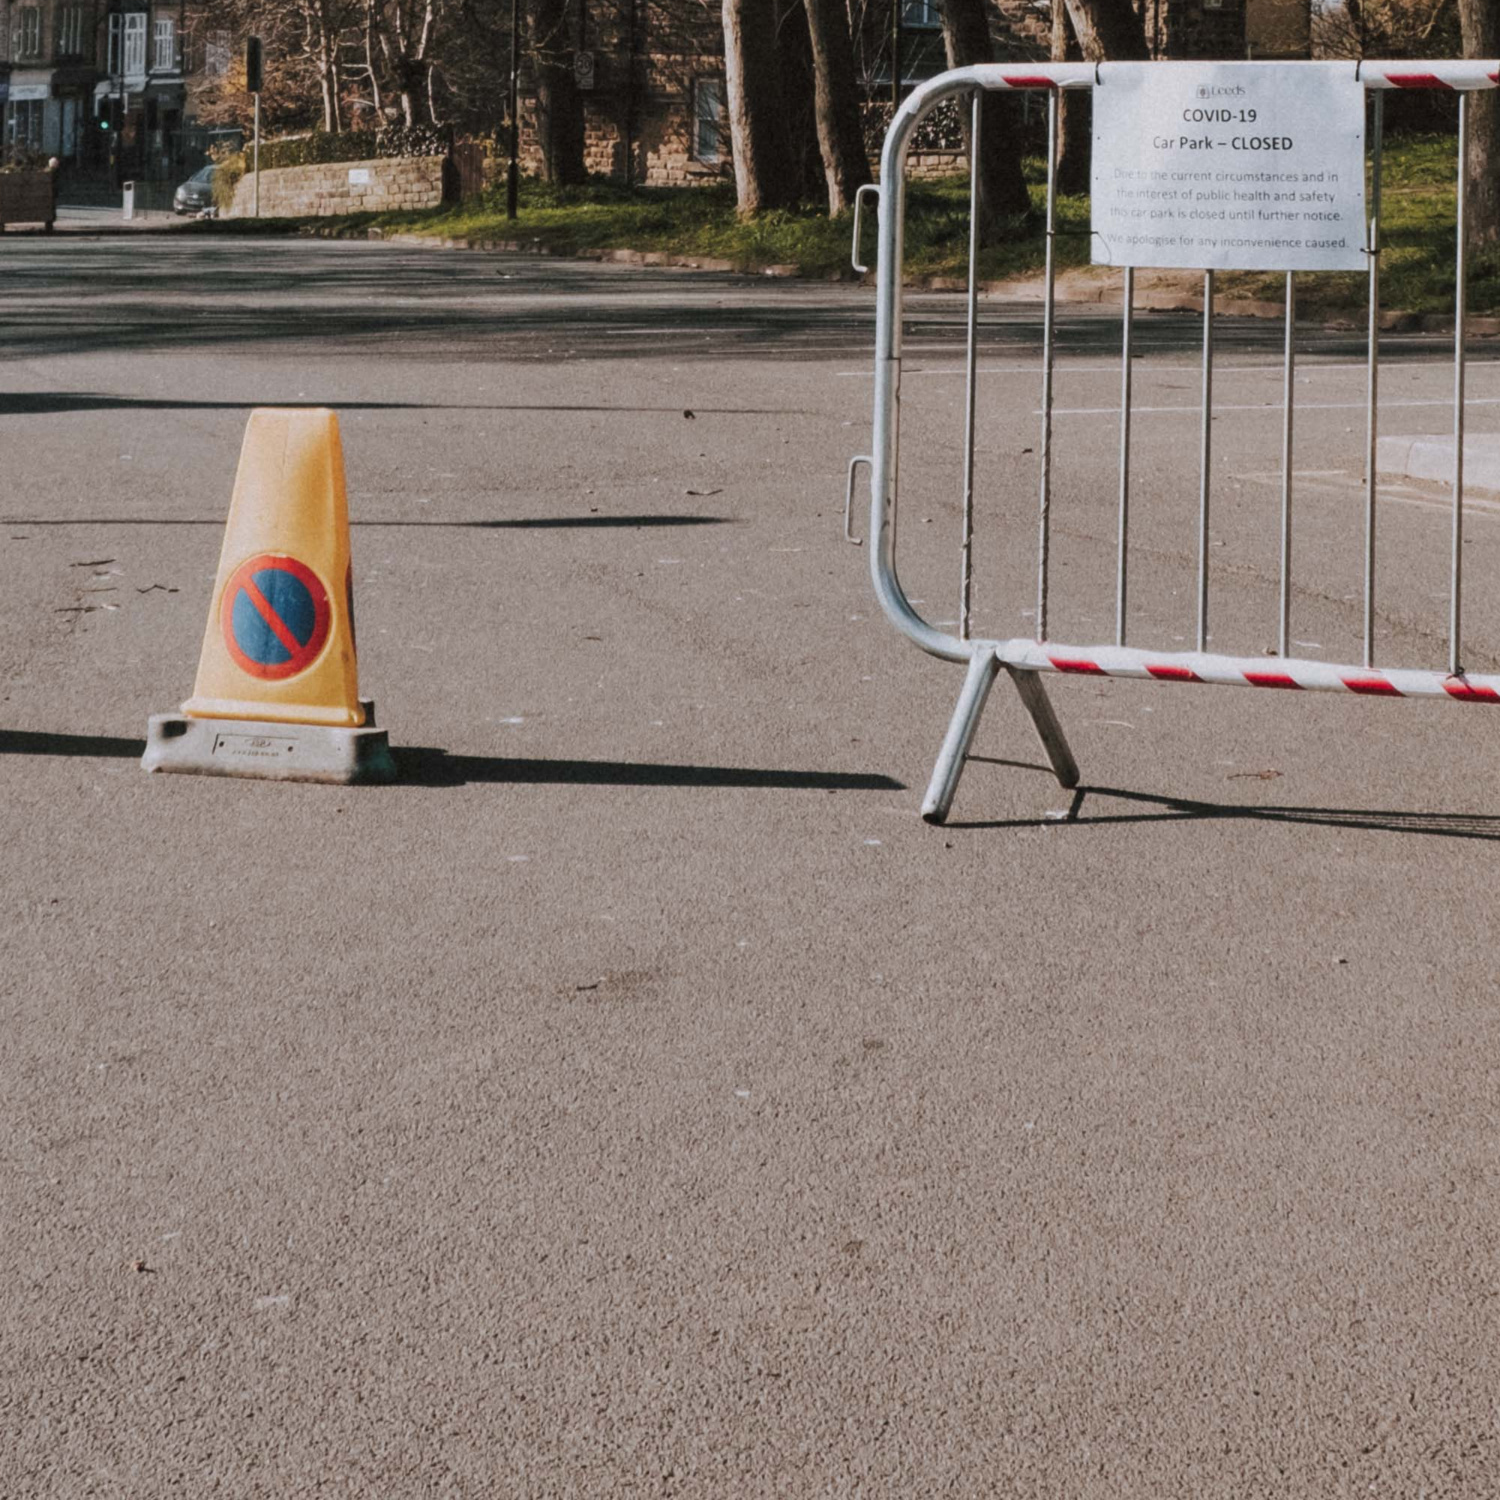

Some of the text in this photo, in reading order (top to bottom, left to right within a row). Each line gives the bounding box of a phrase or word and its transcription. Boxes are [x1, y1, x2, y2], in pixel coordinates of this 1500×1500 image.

[1183, 109, 1257, 123] COVID-19
[1153, 136, 1173, 149] Car
[1180, 137, 1213, 150] Park
[1231, 137, 1293, 150] CLOSED
[1114, 169, 1134, 179] Due
[1151, 171, 1168, 180] the
[1171, 172, 1211, 181] current
[1216, 172, 1298, 182] circumstances
[1302, 172, 1324, 182] and
[1328, 173, 1338, 182] in
[1117, 188, 1335, 204] the interest of public health and safety
[1131, 209, 1146, 217] car
[1150, 208, 1174, 219] park
[1178, 208, 1186, 218] is
[1190, 209, 1225, 220] closed
[1229, 210, 1254, 220] until
[1258, 210, 1300, 220] further
[1303, 212, 1343, 221] notice.
[1107, 234, 1349, 248] We apologise for any inconvenience caused.
